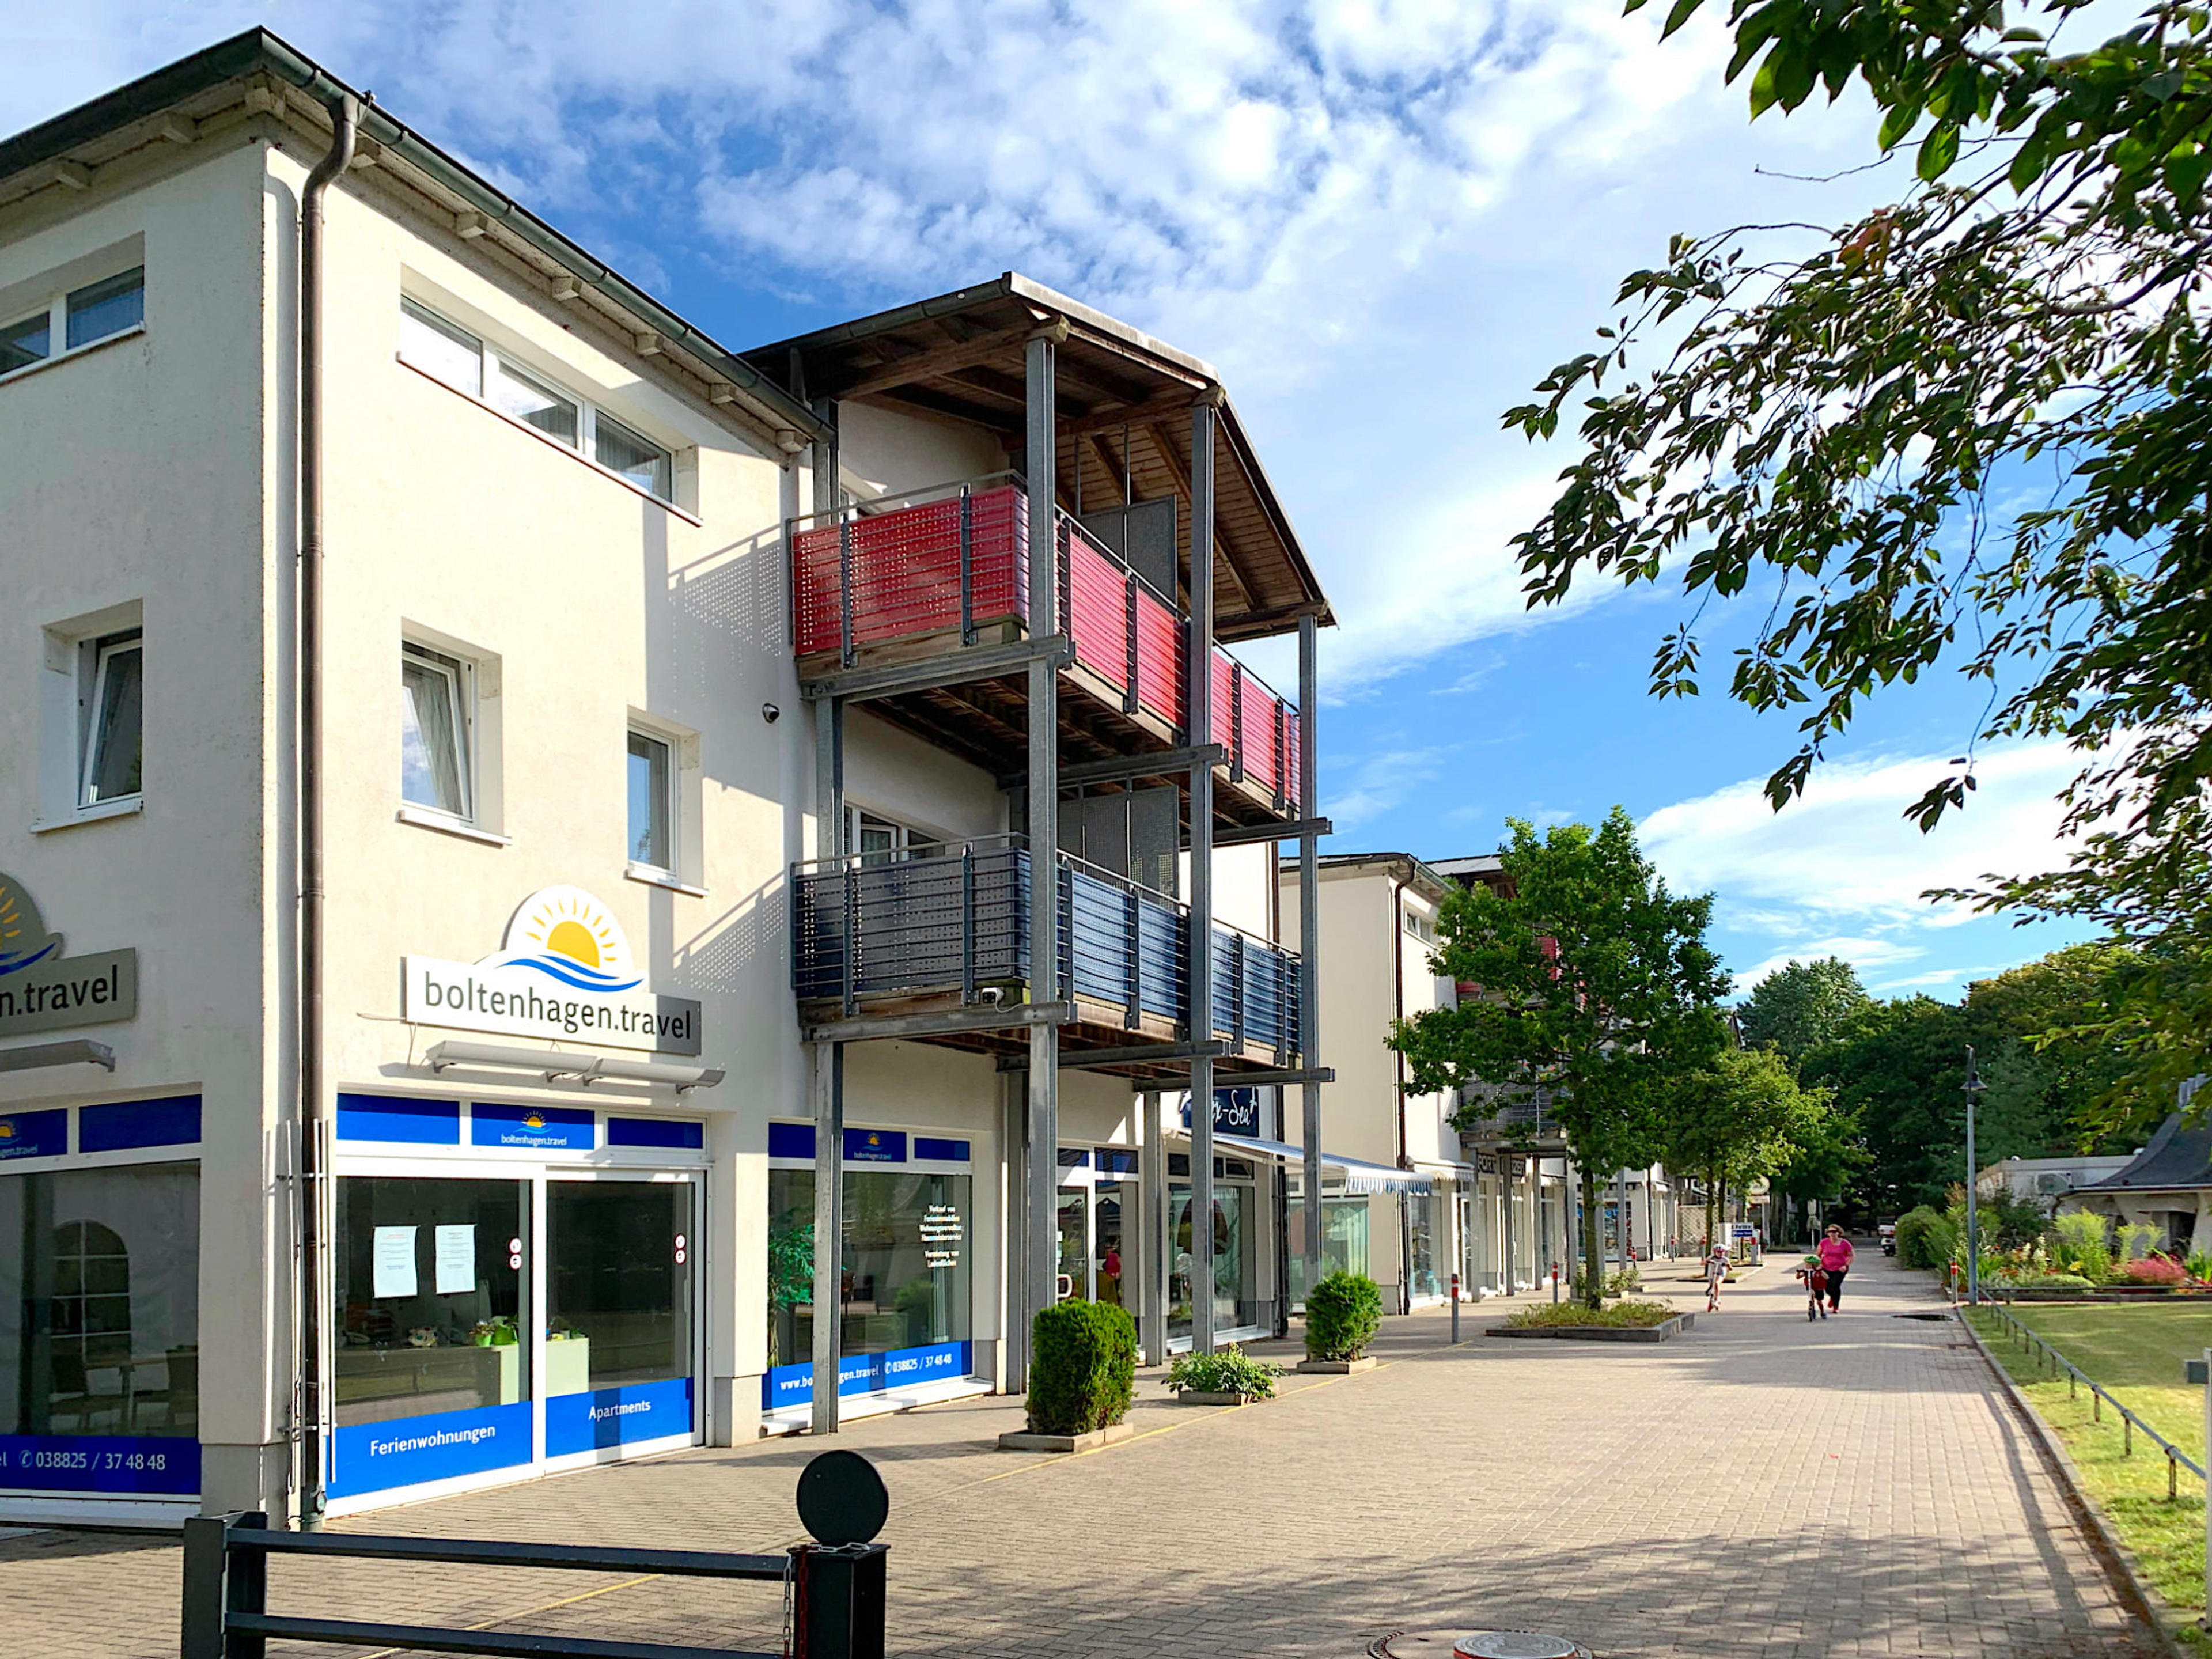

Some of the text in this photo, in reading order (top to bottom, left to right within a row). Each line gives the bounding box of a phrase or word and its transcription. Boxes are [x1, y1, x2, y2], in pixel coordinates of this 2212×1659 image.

[425, 971, 691, 1040] boltenhagen.travel
[501, 1134, 567, 1149] boltenhagen.travel
[780, 1364, 879, 1391] www.bogen.travel
[893, 1359, 918, 1373] 038825
[588, 1399, 652, 1422] Apartments
[370, 1426, 497, 1457] Ferienwohnungen
[36, 1452, 87, 1468] 038825
[91, 1452, 101, 1472] /
